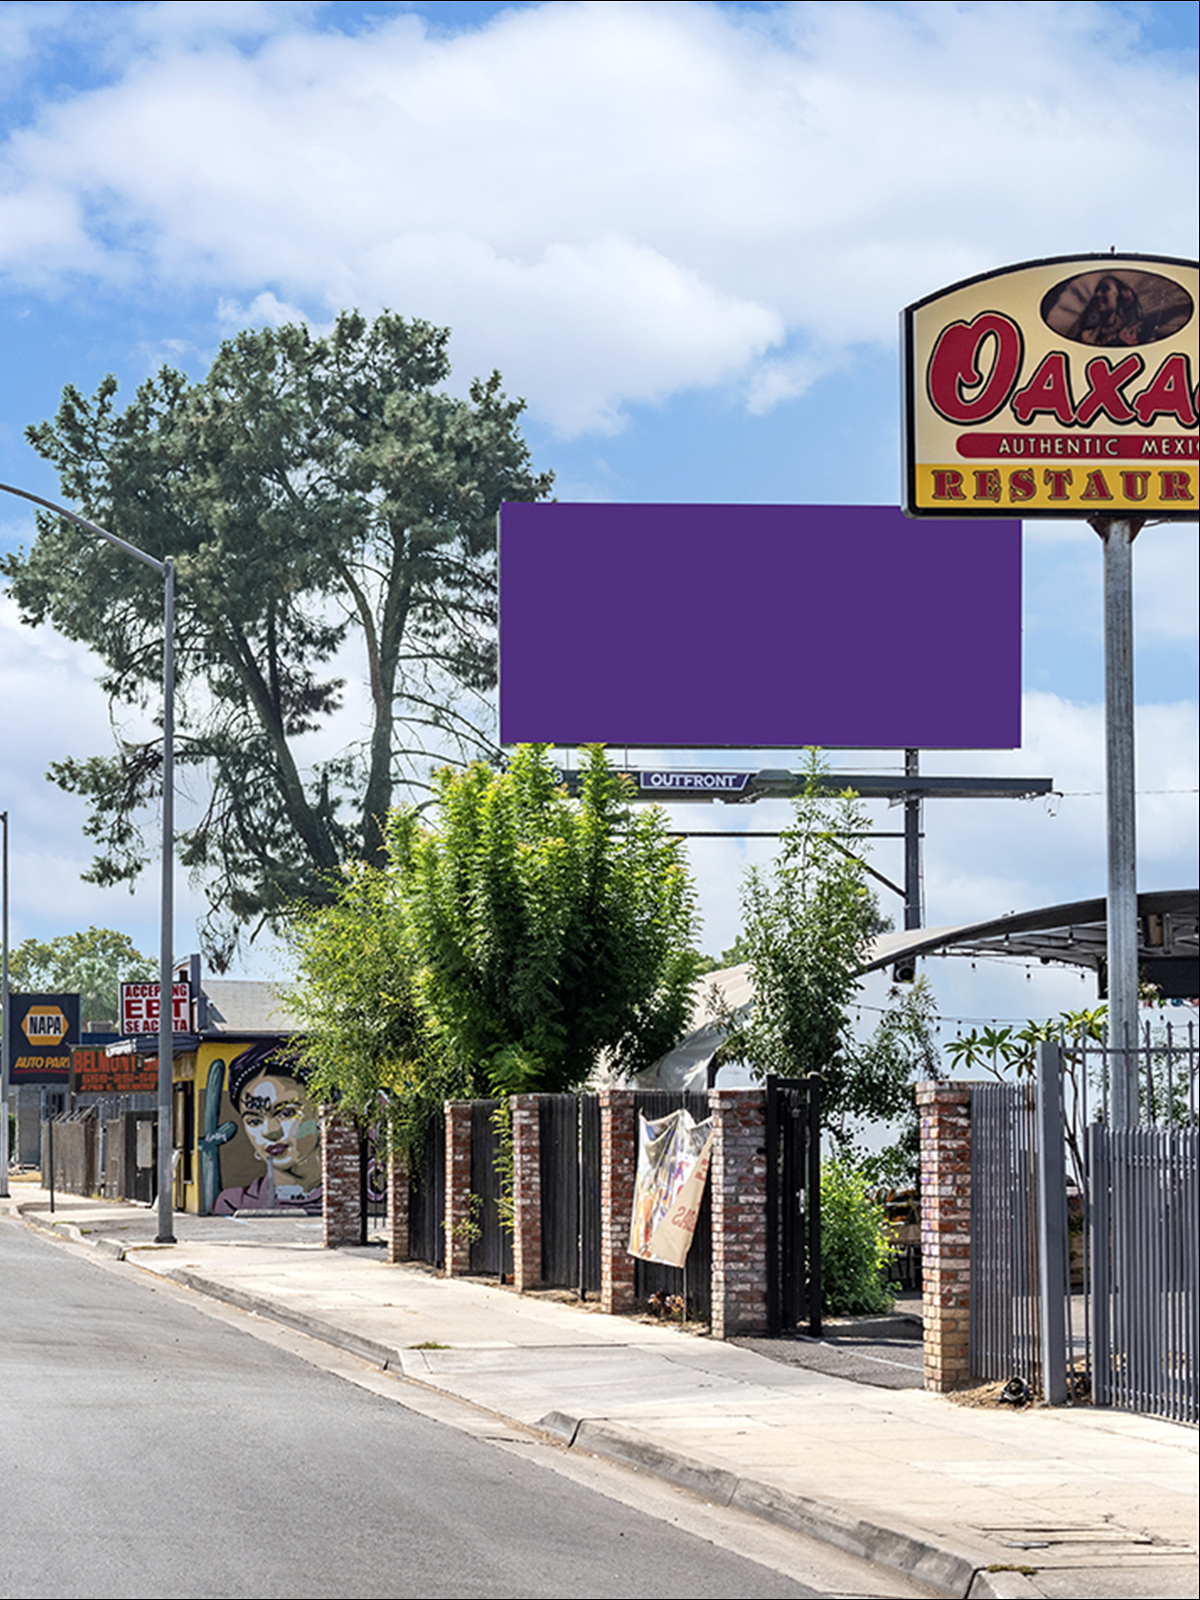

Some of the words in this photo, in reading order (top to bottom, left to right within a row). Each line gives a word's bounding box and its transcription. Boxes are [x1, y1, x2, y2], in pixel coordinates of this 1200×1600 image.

[926, 310, 1199, 429] OAXA
[999, 438, 1119, 455] AUTHENTIC
[1141, 438, 1199, 455] MEXI
[931, 468, 1194, 502] RESTAUR
[650, 773, 737, 788] OUTFRONT
[125, 984, 187, 998] ACCEPNG
[125, 998, 187, 1019] EBT
[29, 1015, 62, 1035] NAPA
[125, 1020, 140, 1033] SE
[142, 1019, 188, 1033] ACTA
[14, 1056, 45, 1069] AUTO
[45, 1056, 71, 1069] PART
[73, 1051, 136, 1073] BELMONT
